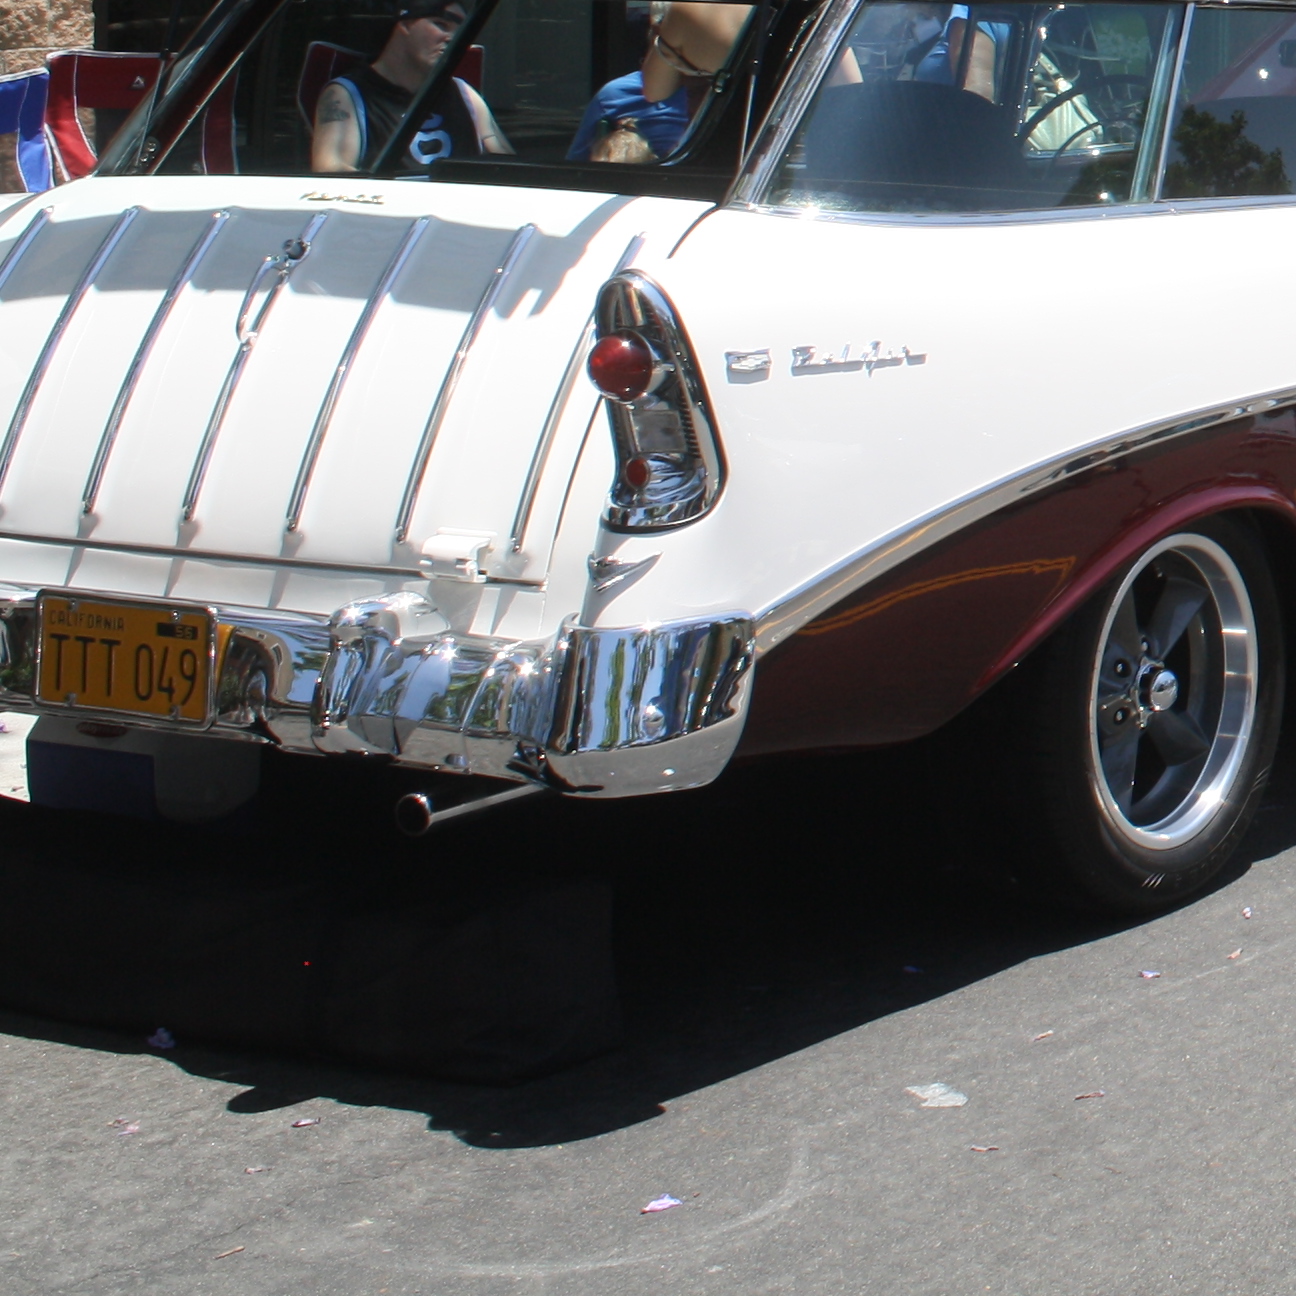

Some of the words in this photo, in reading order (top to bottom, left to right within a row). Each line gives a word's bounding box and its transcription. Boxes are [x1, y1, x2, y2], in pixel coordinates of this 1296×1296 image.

[50, 610, 125, 631] CALIFORNIA
[50, 633, 121, 697] TTT
[134, 643, 198, 706] 049
